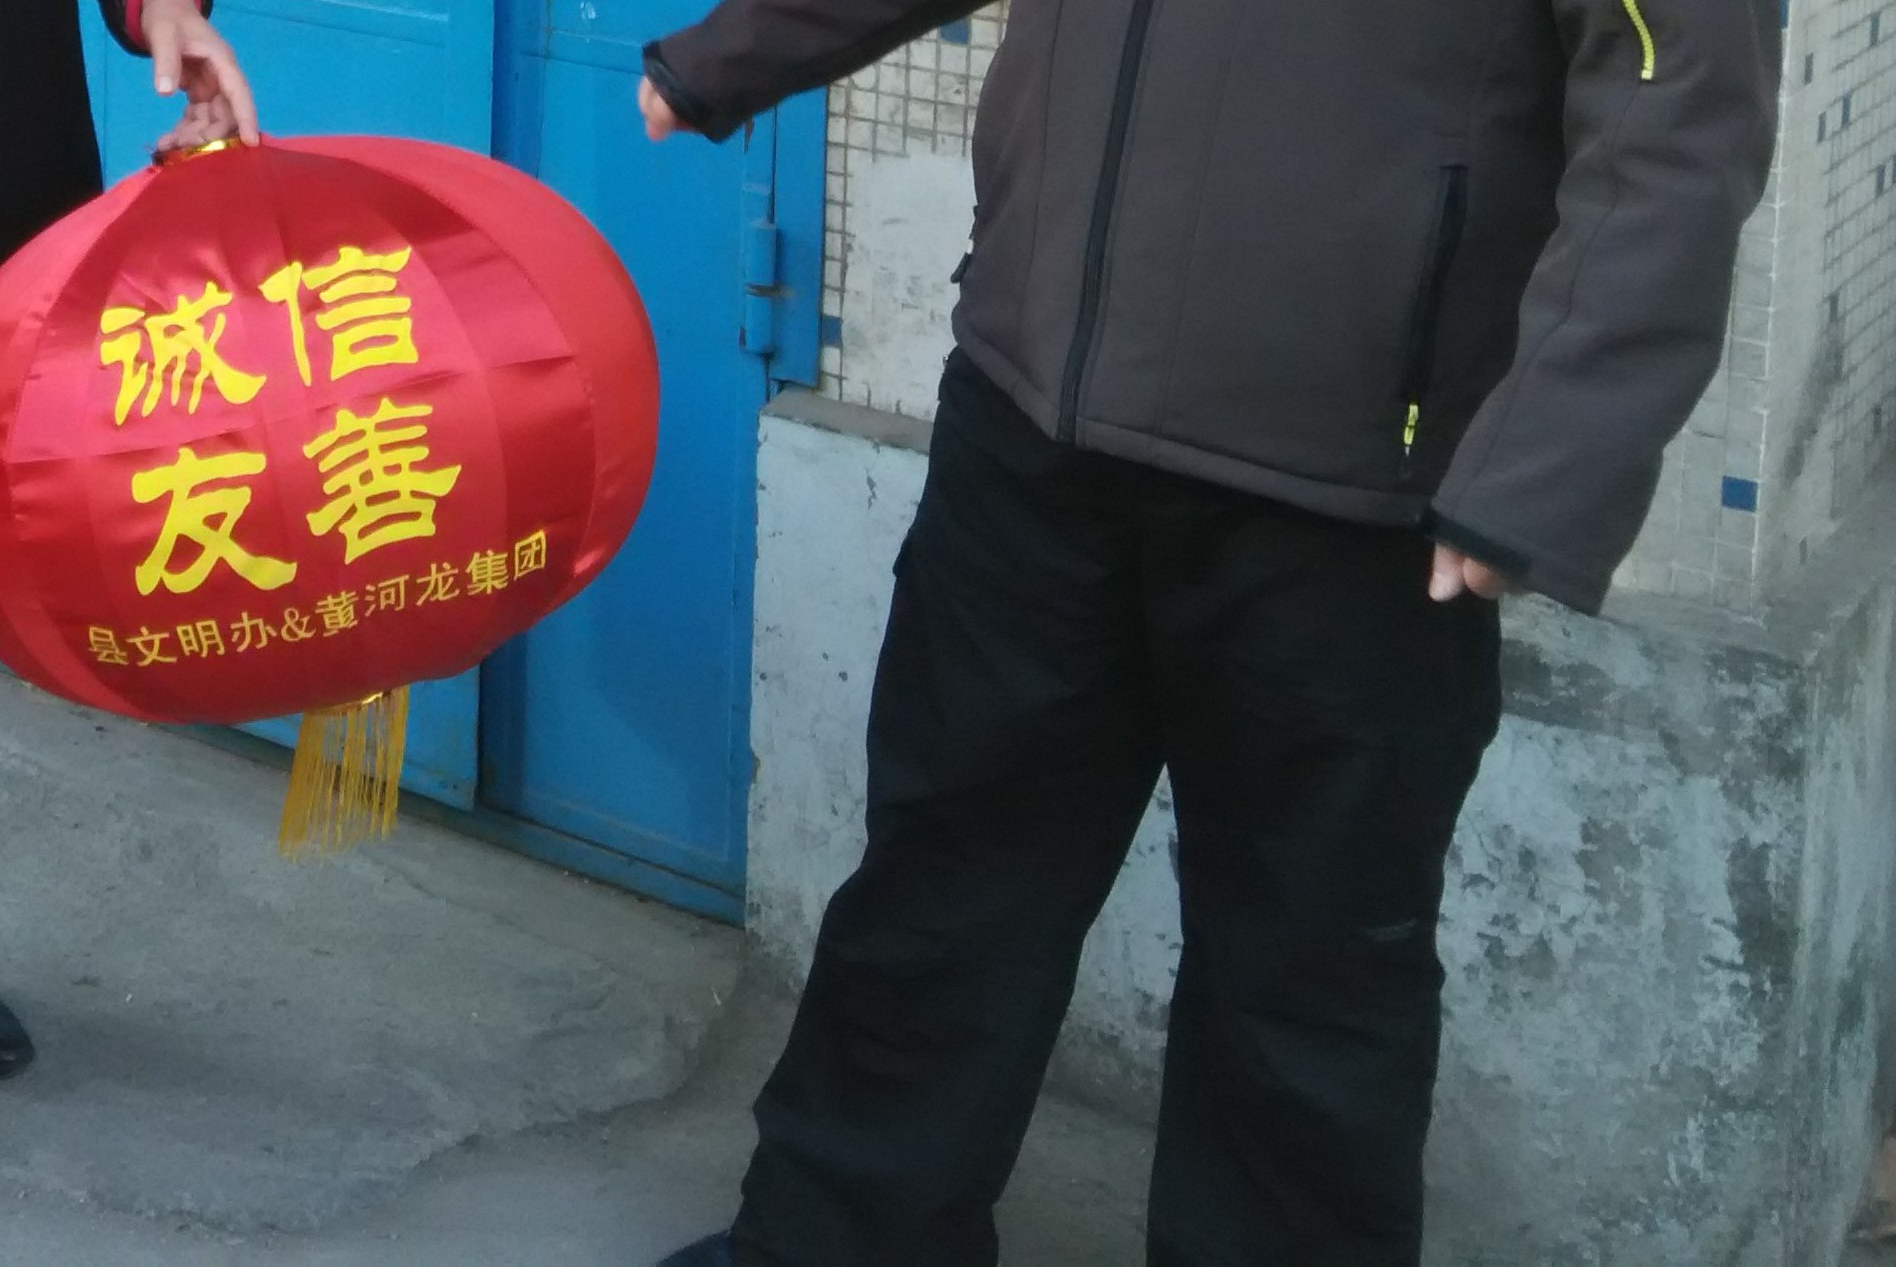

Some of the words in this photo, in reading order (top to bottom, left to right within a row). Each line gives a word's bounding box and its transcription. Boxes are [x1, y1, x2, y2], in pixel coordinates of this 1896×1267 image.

[100, 246, 419, 426] 诚信
[131, 397, 463, 596] 友善
[88, 529, 548, 668] 县文明办&黄河龙集团
